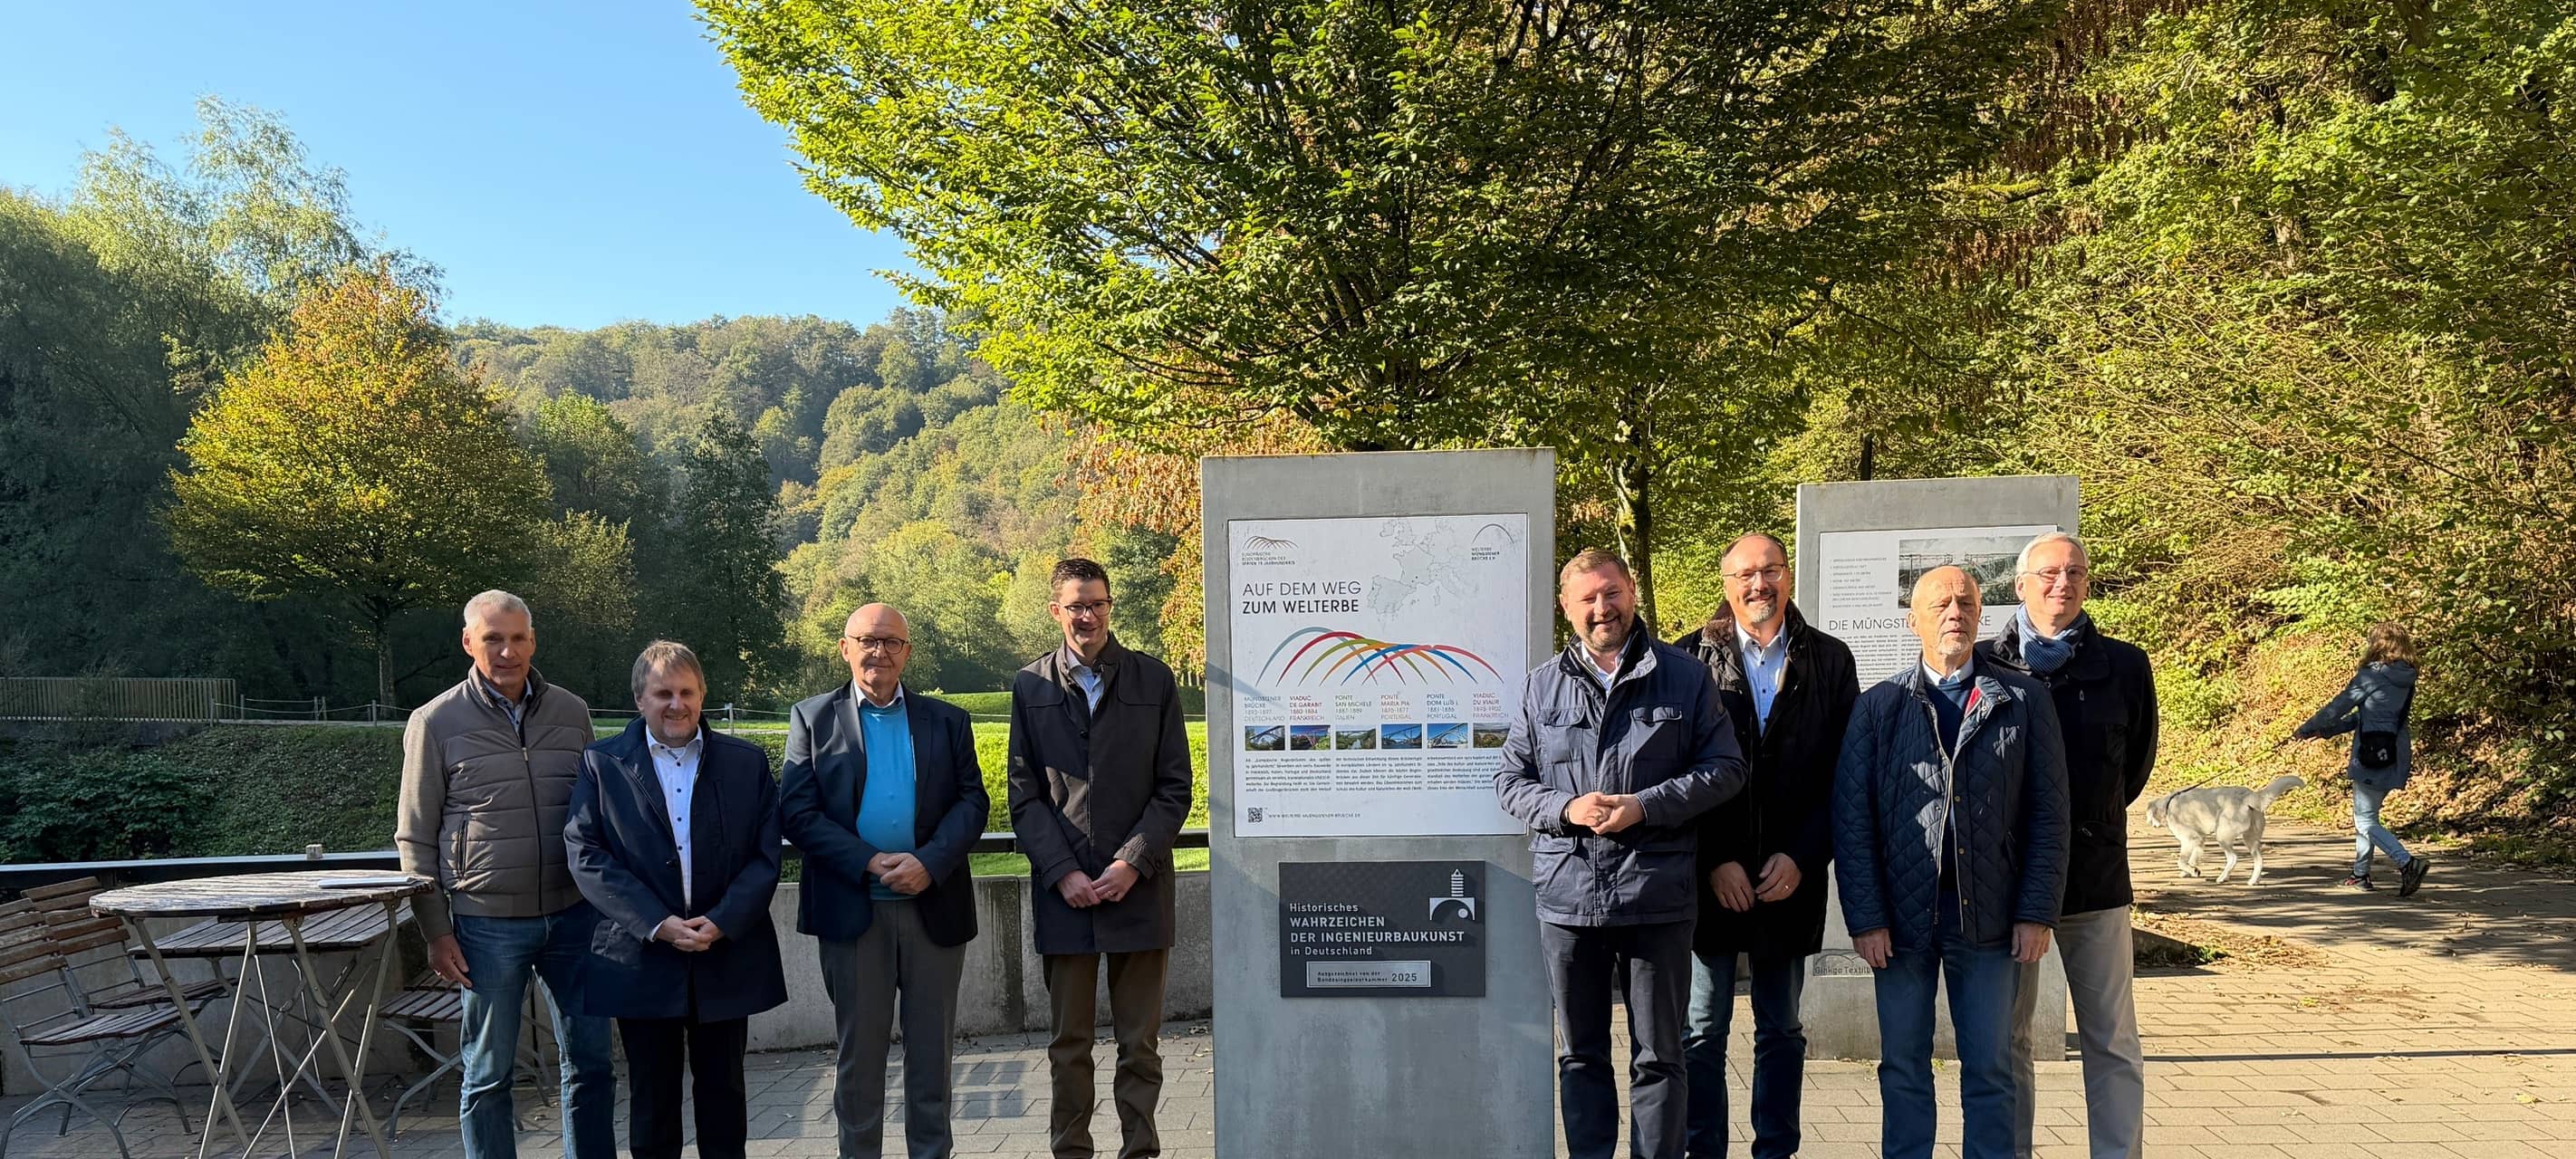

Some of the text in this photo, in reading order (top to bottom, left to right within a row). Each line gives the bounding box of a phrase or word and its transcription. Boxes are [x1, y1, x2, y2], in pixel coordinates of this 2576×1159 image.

[1243, 581, 1361, 596] AUF DEM WEG
[1243, 599, 1359, 614] ZUM WELTERBE
[1829, 617, 1909, 630] DIE MÜNGST
[1290, 903, 1359, 913] Historisches
[1290, 916, 1385, 927] WAHRZEICHEN
[1291, 931, 1465, 943] DER INGENIEURBAUKUNST
[1291, 946, 1373, 956] in Deutschland
[1814, 965, 1872, 976] Ginkgo Textilb
[1391, 972, 1418, 982] 2025
